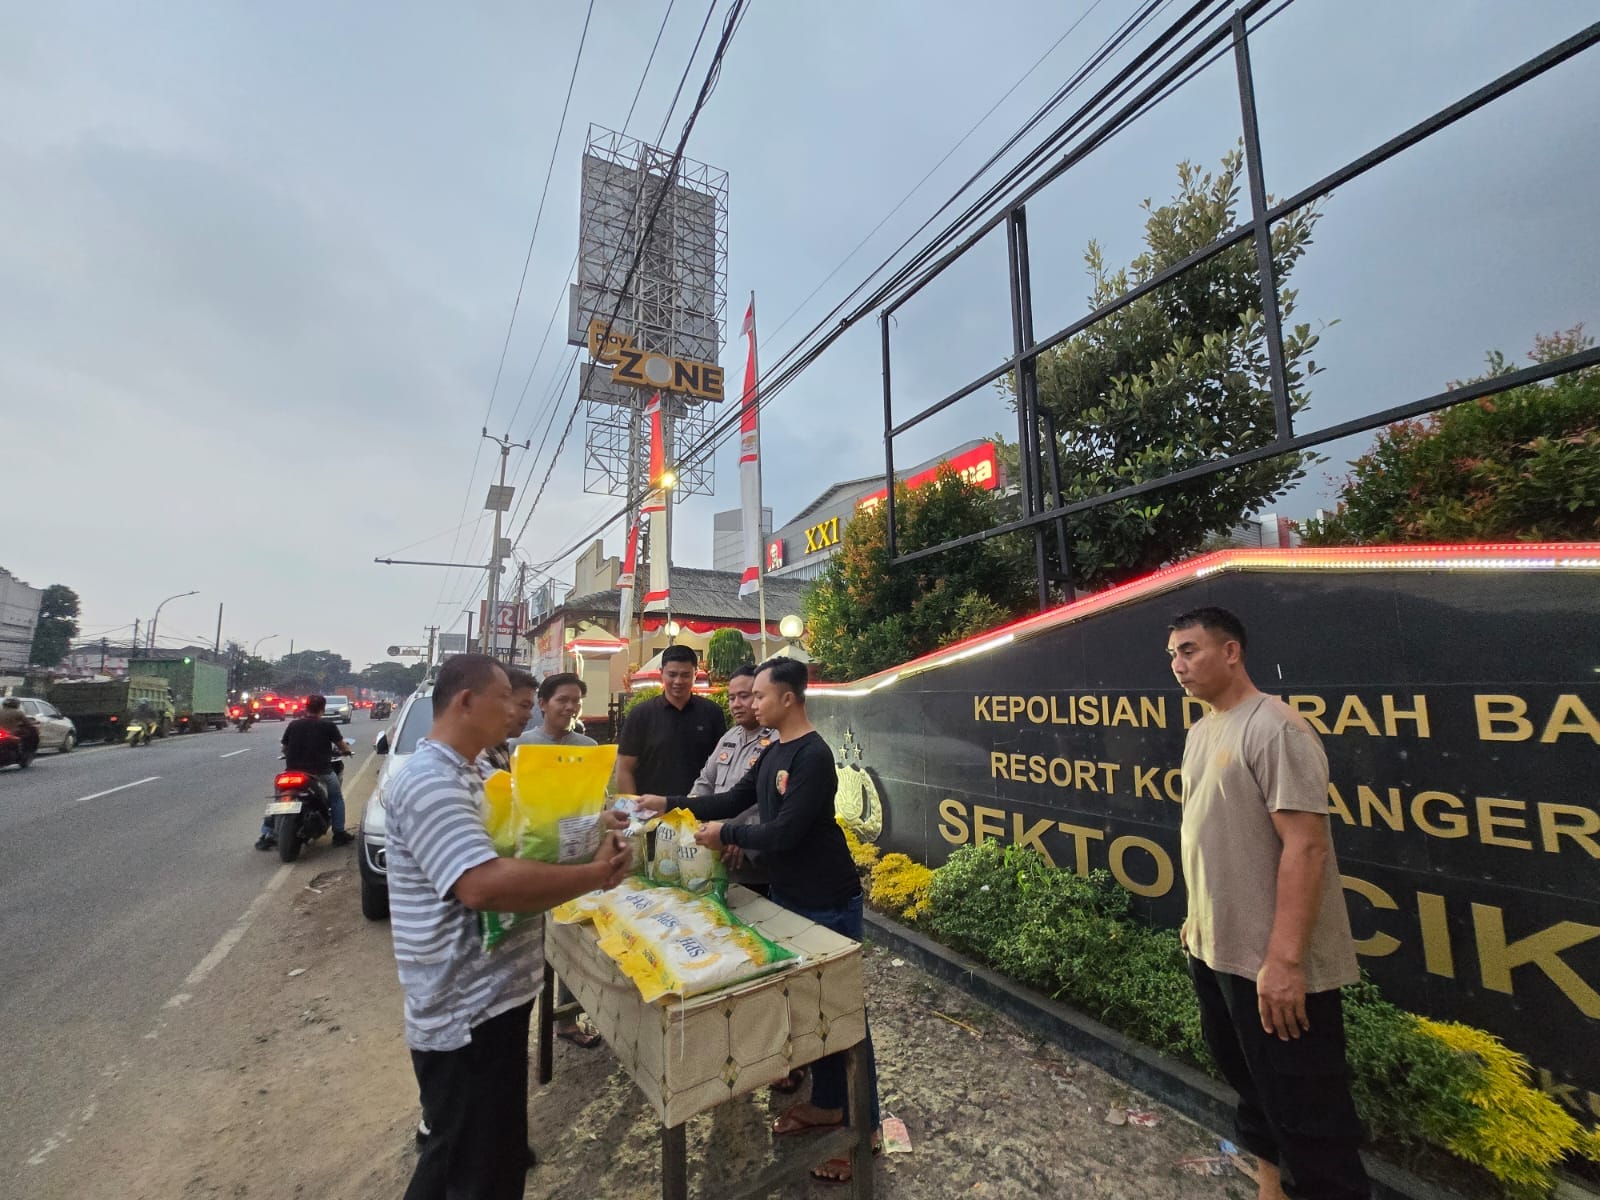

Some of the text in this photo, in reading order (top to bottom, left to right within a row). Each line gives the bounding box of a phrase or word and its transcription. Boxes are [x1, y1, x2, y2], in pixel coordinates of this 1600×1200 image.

[618, 350, 721, 394] ZONE
[804, 517, 839, 554] XXI
[974, 694, 1600, 744] KEPOLISIAN DRAH BA
[991, 752, 1600, 860] RESORT KO ANGER
[938, 798, 1174, 898] SEKTO
